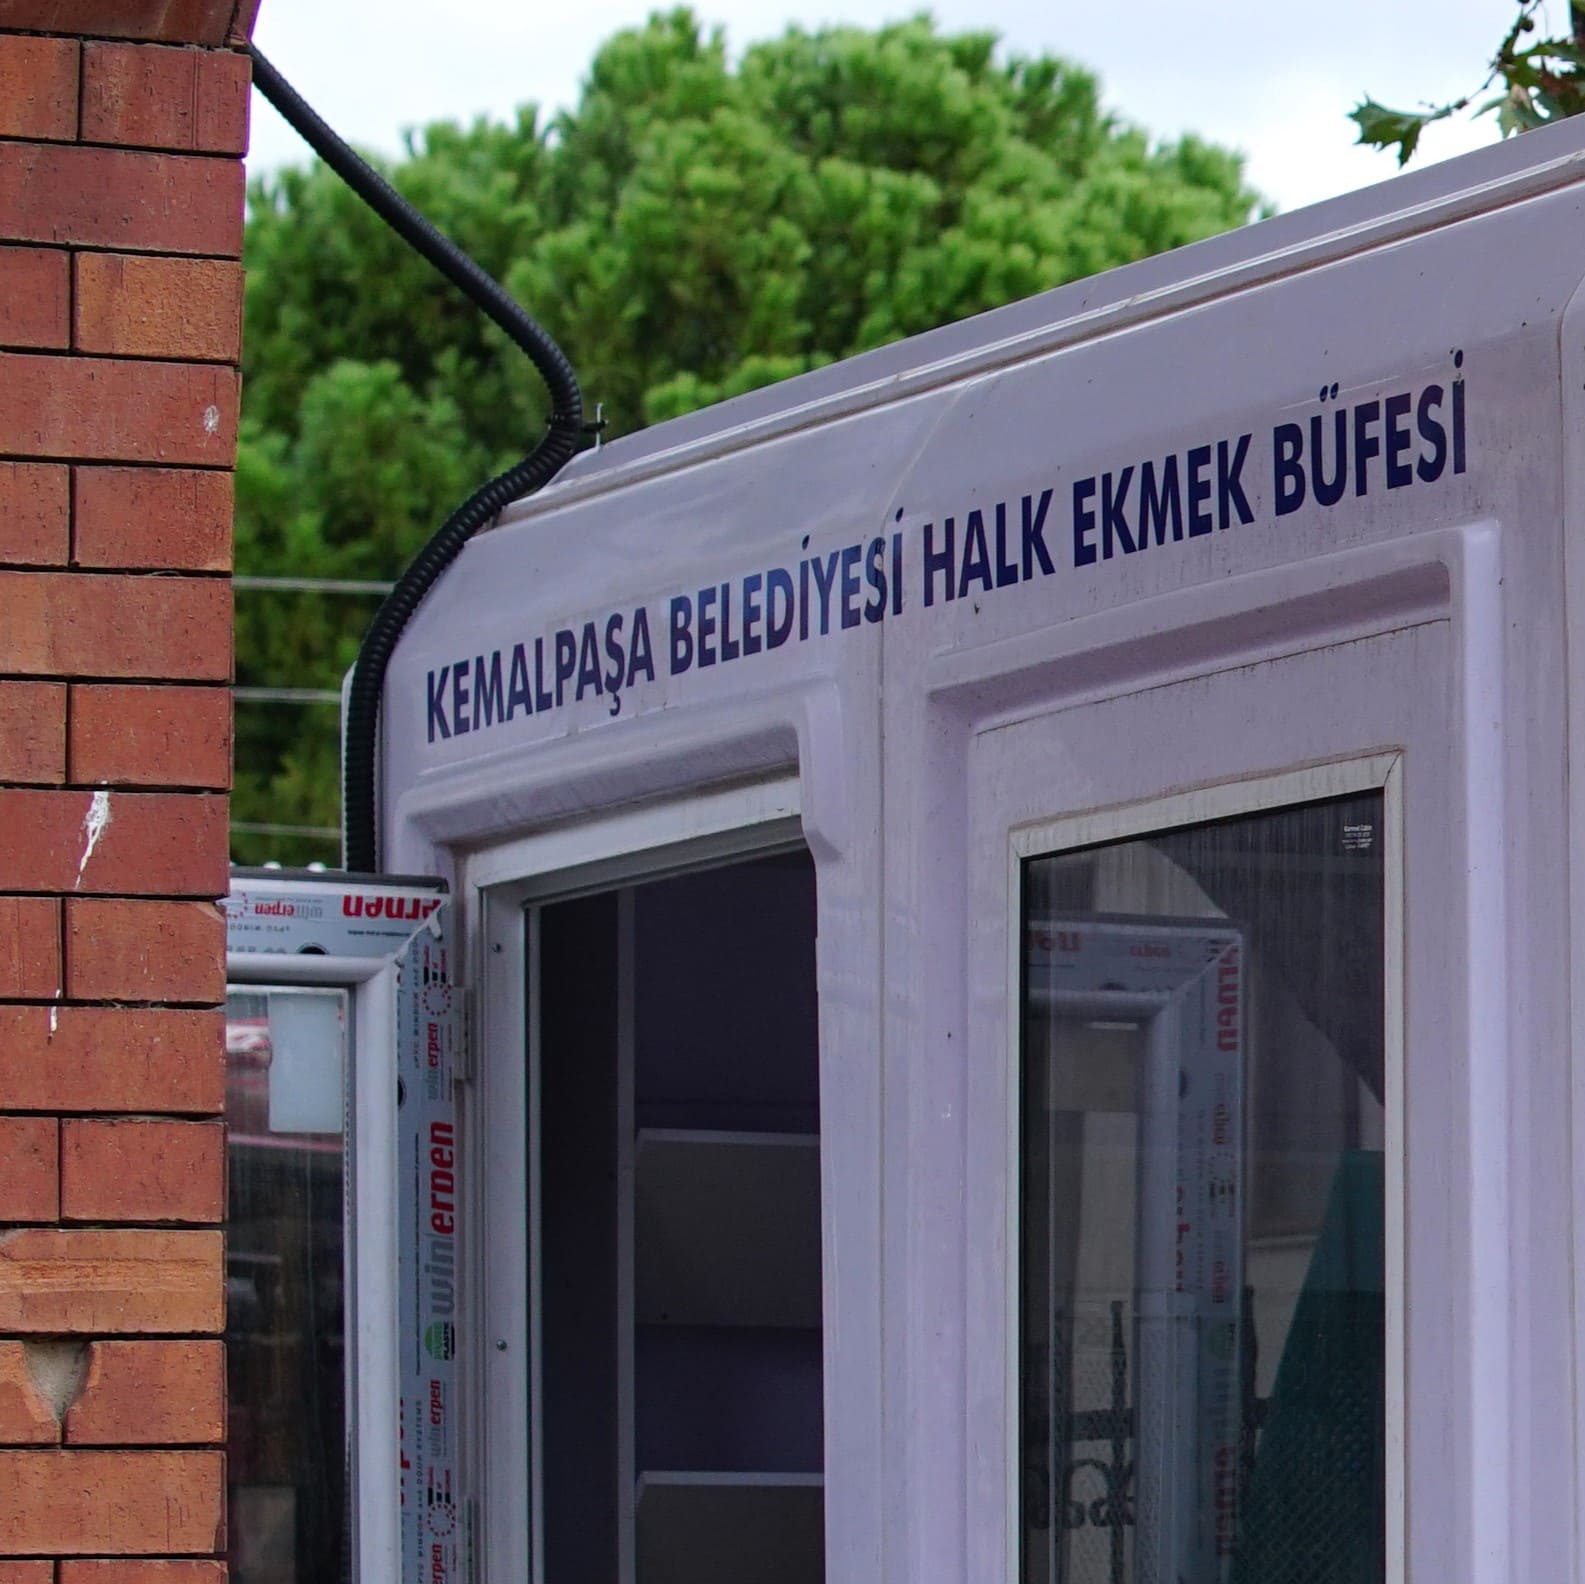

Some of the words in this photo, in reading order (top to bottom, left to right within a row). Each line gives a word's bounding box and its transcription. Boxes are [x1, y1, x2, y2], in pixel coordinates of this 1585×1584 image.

[425, 611, 656, 744] KEMALPAŞA
[669, 506, 906, 674] BELEDİYESİ
[922, 489, 1056, 608] HALK
[1071, 434, 1255, 569] EKMEK
[1272, 349, 1468, 518] BÜFESİ
